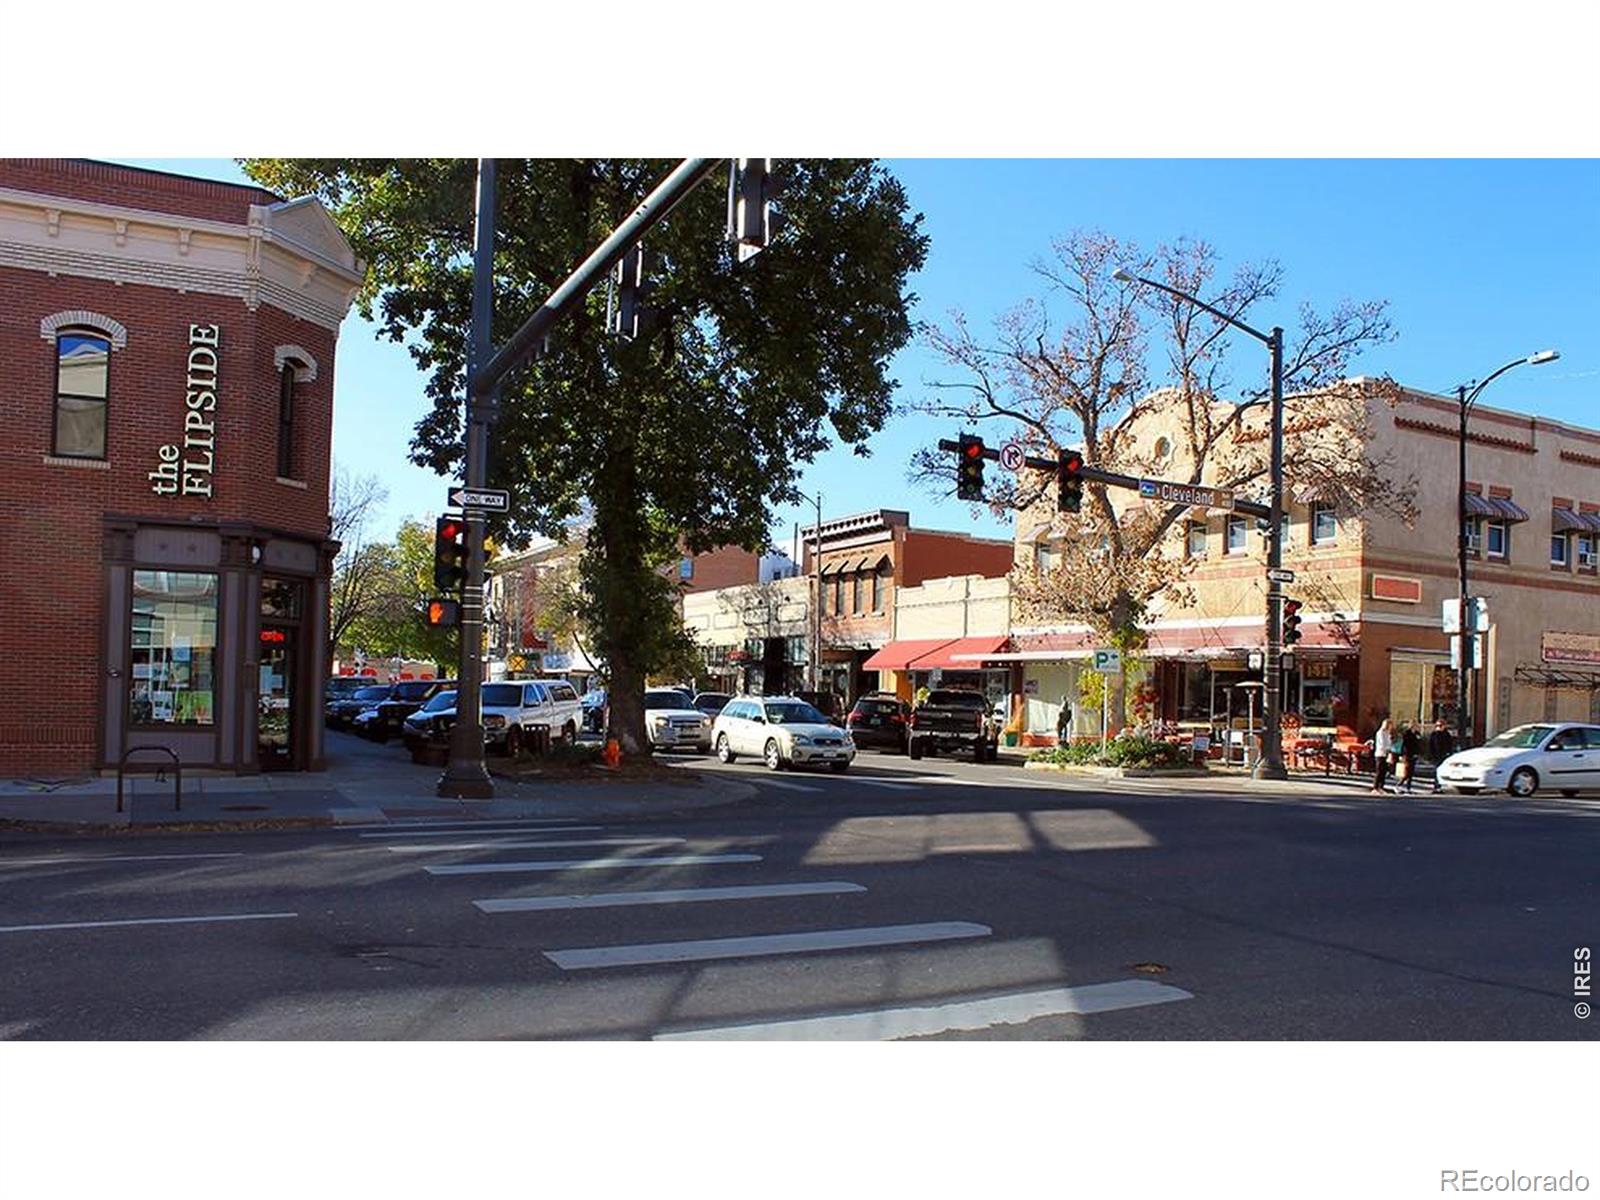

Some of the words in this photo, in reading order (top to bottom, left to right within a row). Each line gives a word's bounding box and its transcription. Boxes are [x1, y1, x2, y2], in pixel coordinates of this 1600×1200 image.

[182, 323, 219, 498] FLIPSIDE
[148, 444, 180, 495] the
[1161, 484, 1215, 505] Cleveland
[1096, 652, 1109, 669] P
